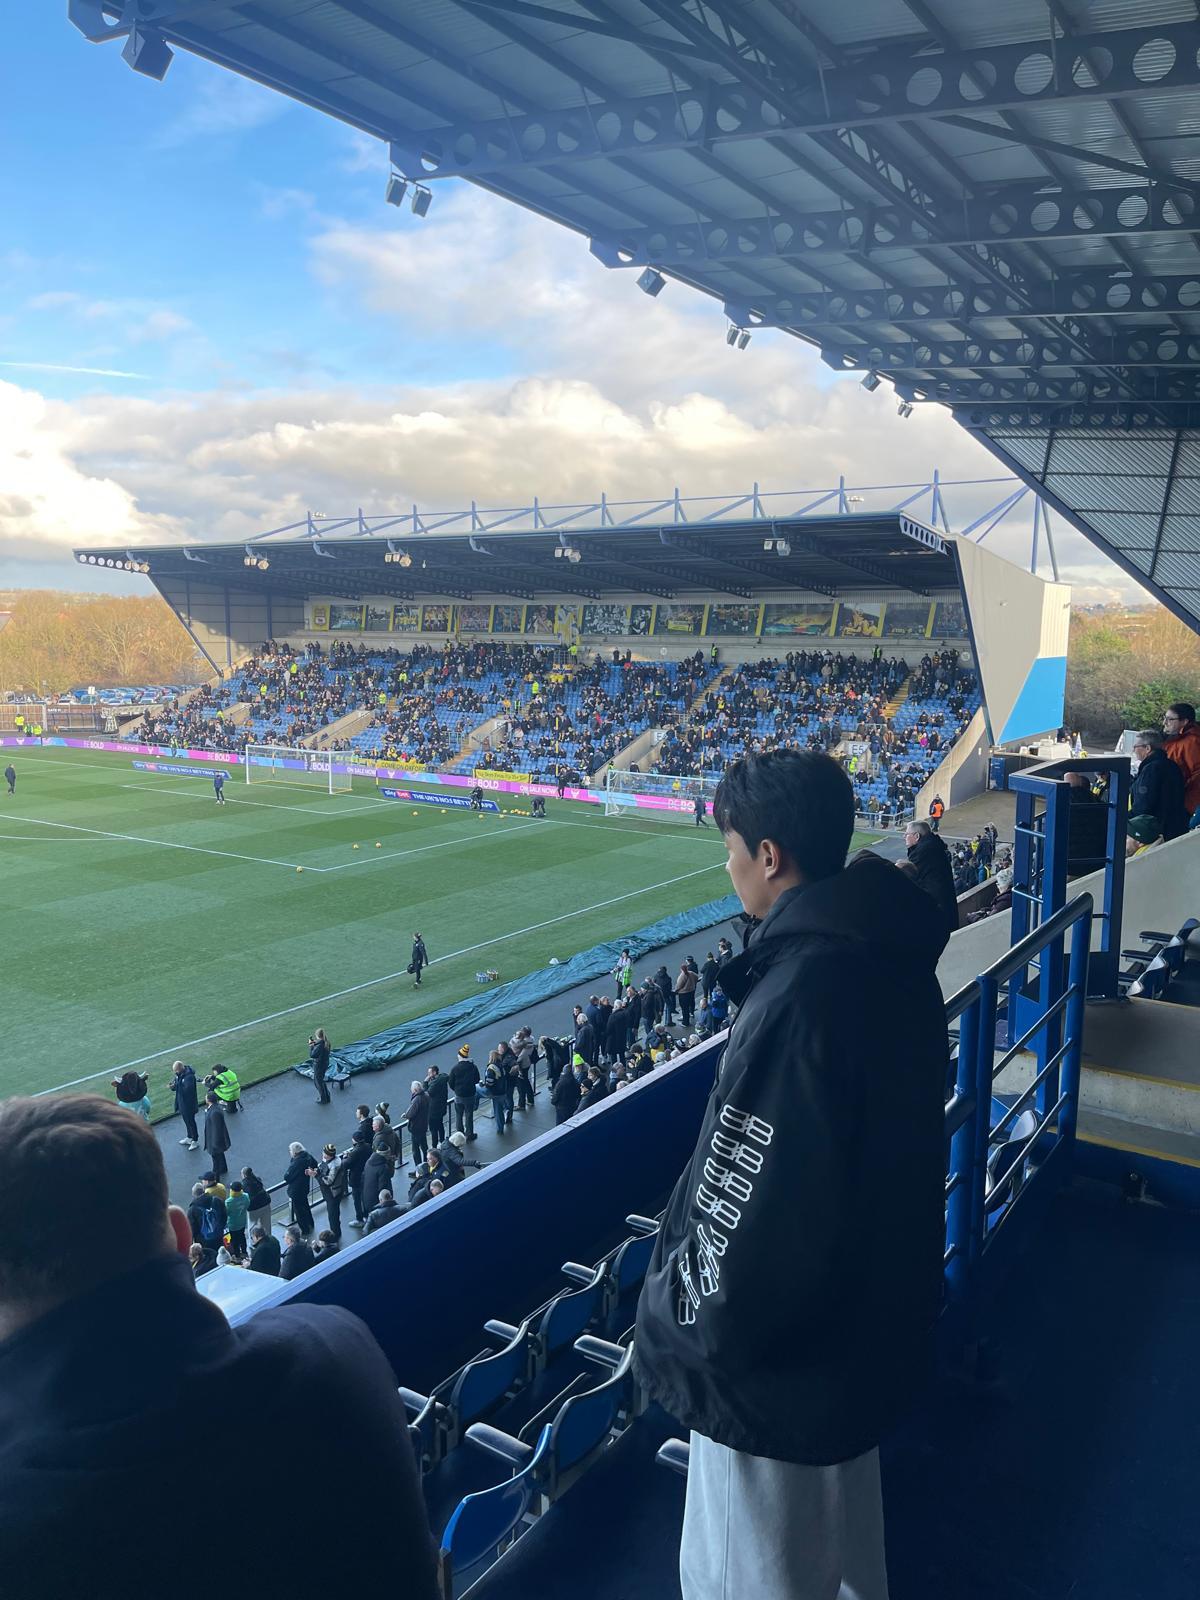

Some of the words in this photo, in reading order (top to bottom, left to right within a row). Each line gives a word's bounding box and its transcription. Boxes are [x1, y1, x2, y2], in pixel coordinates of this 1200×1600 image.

[90, 741, 104, 749] BOLD
[215, 753, 230, 761] BOLD
[467, 778, 477, 787] BE
[478, 779, 499, 789] BOLD
[384, 790, 396, 798] sky
[541, 787, 558, 795] NOW
